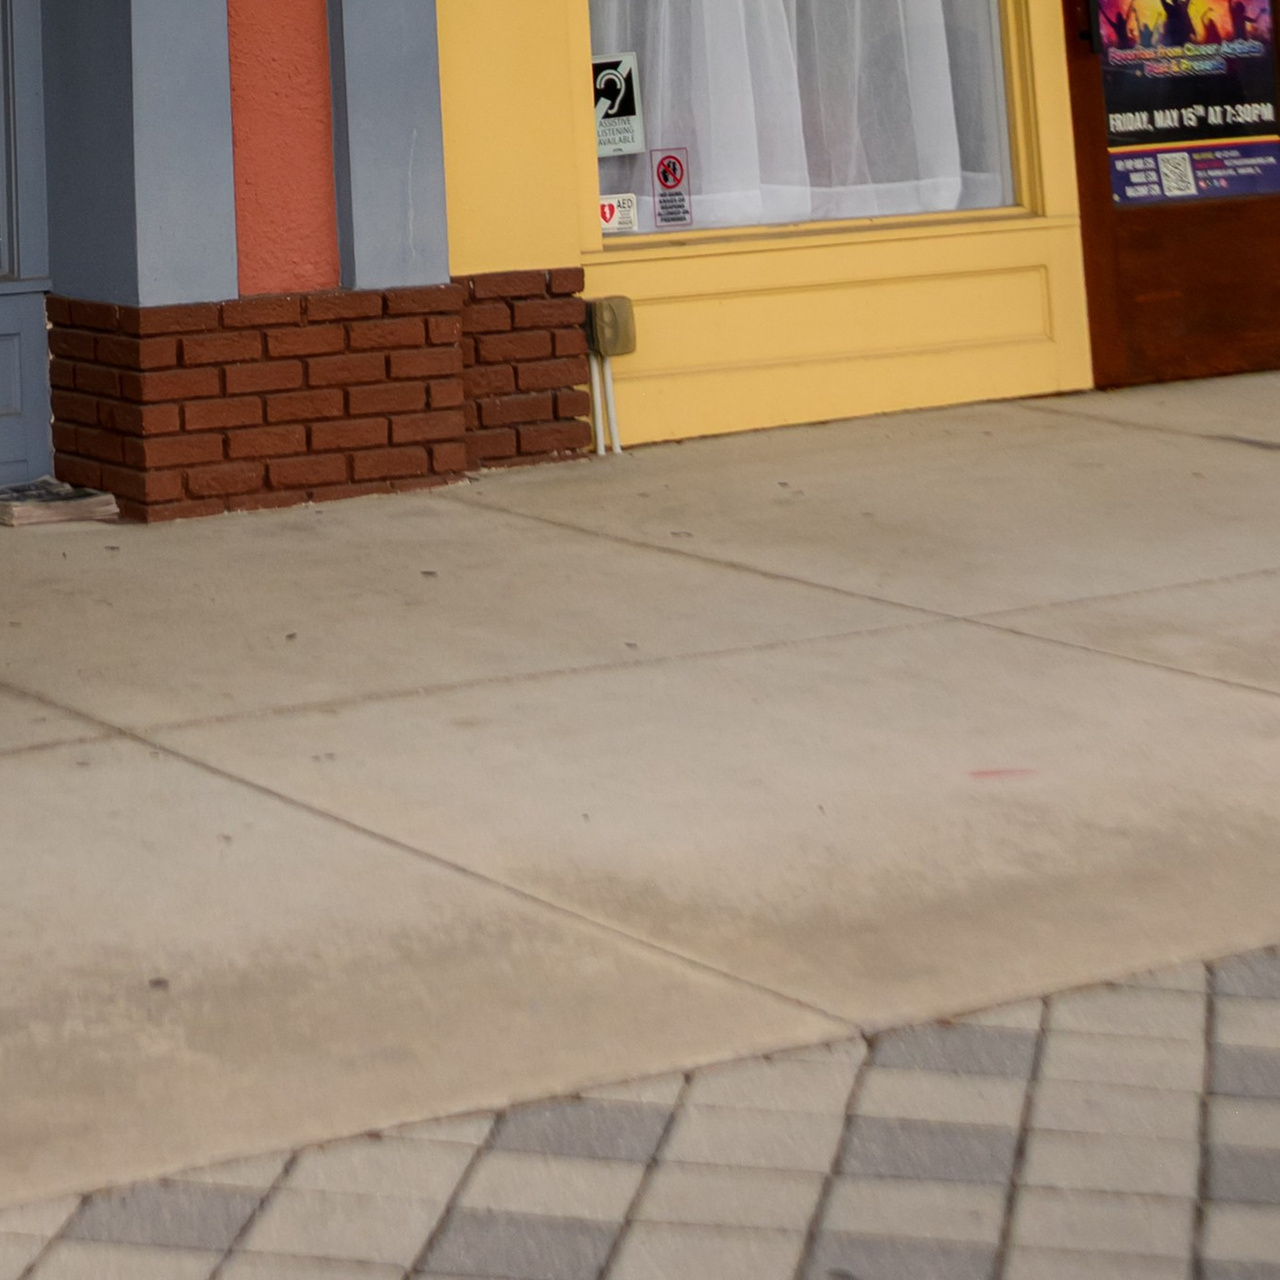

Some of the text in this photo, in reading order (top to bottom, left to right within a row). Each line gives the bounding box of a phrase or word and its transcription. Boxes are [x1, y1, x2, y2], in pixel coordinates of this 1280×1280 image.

[599, 118, 632, 128] ASSISTIVE
[1108, 110, 1154, 133] FRIDAY,
[1153, 108, 1181, 129] MAY
[1207, 105, 1225, 126] AT
[1224, 103, 1276, 125] 7:30PM
[598, 126, 635, 137] LISTENING
[598, 135, 636, 145] AVAILABLE
[616, 198, 634, 209] AED
